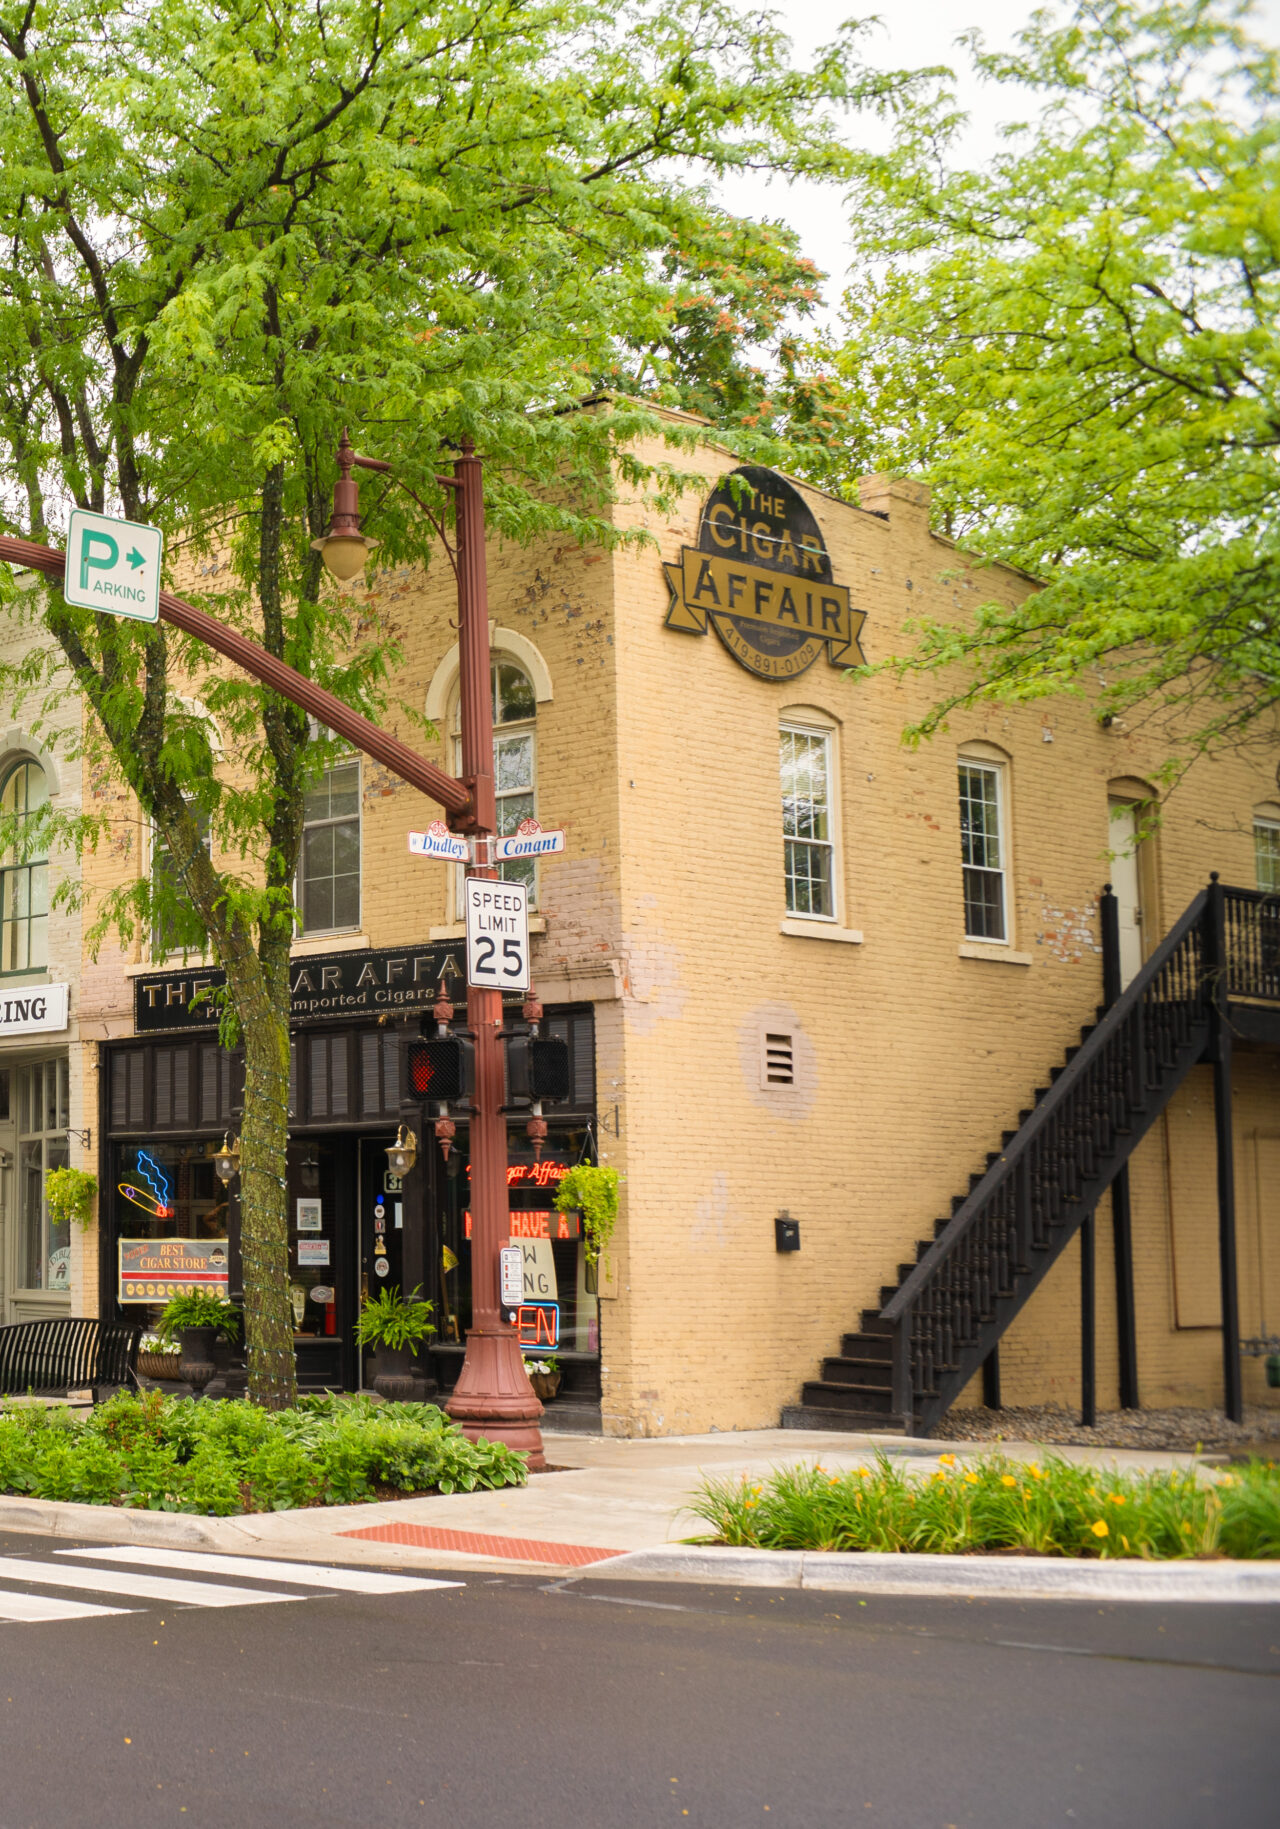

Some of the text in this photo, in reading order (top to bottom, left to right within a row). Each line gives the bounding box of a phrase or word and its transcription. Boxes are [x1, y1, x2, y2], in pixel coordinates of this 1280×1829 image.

[751, 488, 786, 519] THE
[709, 504, 824, 574] CIGAR
[693, 558, 842, 634] AFFAIR
[725, 628, 815, 674] 419-891-0109
[422, 835, 465, 858] Dudley
[503, 836, 558, 856] Conant
[472, 892, 522, 912] SPEED
[478, 914, 516, 933] LIMIT
[475, 936, 523, 977] 25
[142, 979, 212, 1007] THE
[356, 953, 464, 987] AFFA
[292, 987, 435, 1011] mported Cigars
[510, 1211, 550, 1238] HAVE
[160, 1244, 185, 1256] BEST
[140, 1257, 208, 1270] CIGAR STORE
